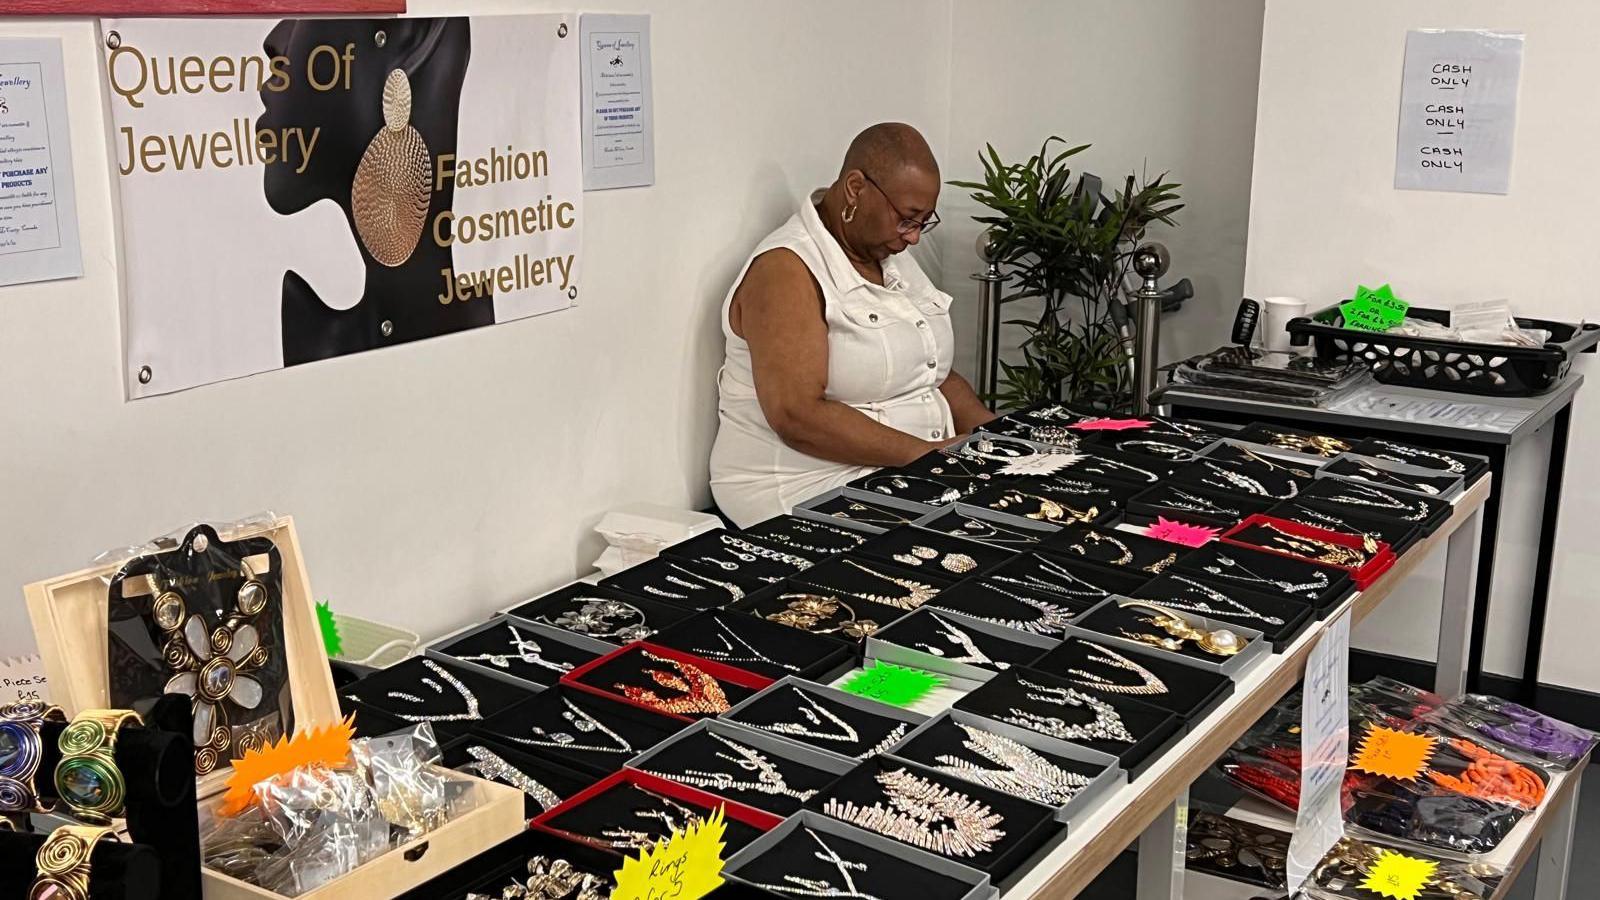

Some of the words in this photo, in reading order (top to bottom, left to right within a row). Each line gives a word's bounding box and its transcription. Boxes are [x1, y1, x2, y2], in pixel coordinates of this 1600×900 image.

[1432, 63, 1472, 74] CASH
[109, 46, 291, 108] Queens
[306, 43, 356, 91] Of
[0, 76, 31, 90] ewellery
[1430, 77, 1469, 87] ONLY
[1425, 104, 1464, 114] CASH
[1425, 118, 1465, 130] ONLY
[120, 118, 320, 176] Jewellery
[1420, 146, 1463, 156] CASH
[35, 166, 48, 175] ANY
[435, 145, 548, 191] Fashion
[1421, 160, 1463, 173] ONLY
[433, 194, 575, 248] Cosmetic
[438, 253, 575, 305] Jewellery
[3, 678, 32, 686] Piece
